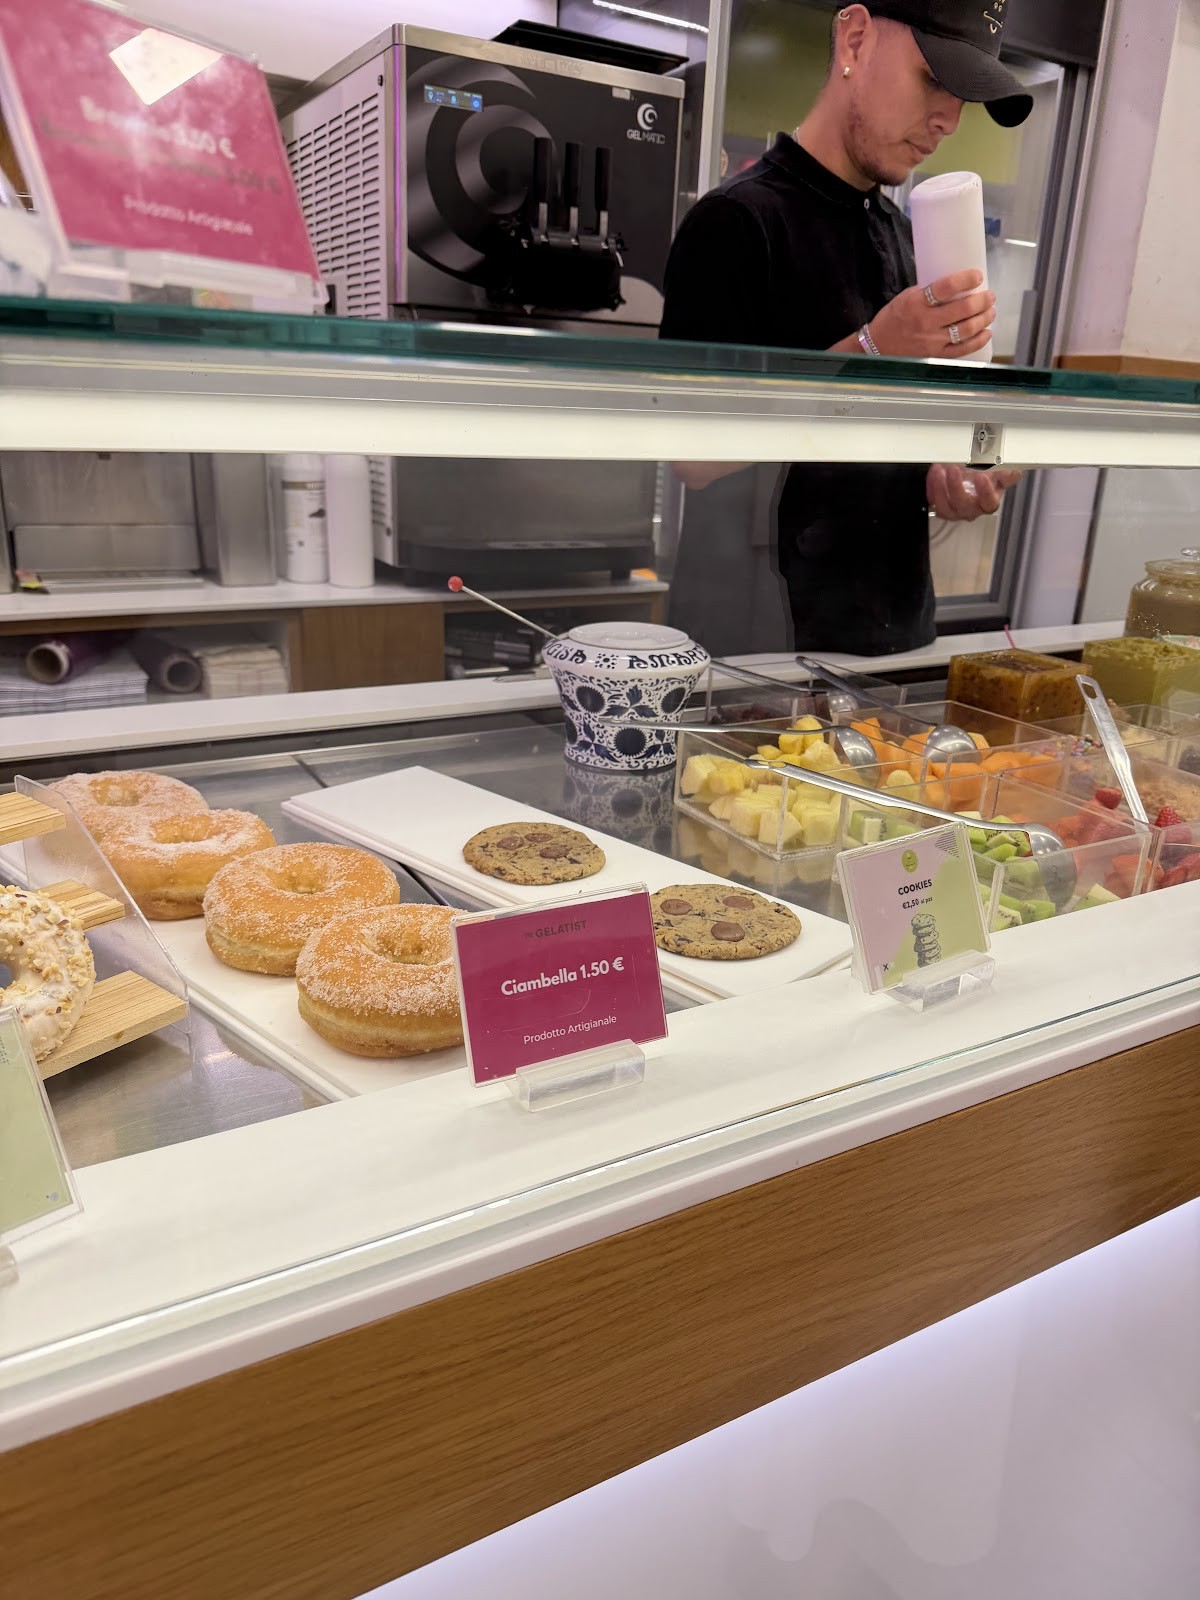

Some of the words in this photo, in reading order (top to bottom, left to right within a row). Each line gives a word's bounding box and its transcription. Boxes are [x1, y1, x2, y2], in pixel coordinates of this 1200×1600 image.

[898, 878, 933, 896] COOKIES
[902, 898, 920, 910] €2,50
[535, 920, 587, 938] GELATIST
[501, 967, 578, 996] Ciambella
[580, 959, 610, 980] 1.50
[612, 956, 625, 972] €
[523, 1027, 566, 1045] Prodotto
[568, 1015, 617, 1034] Artigianale
